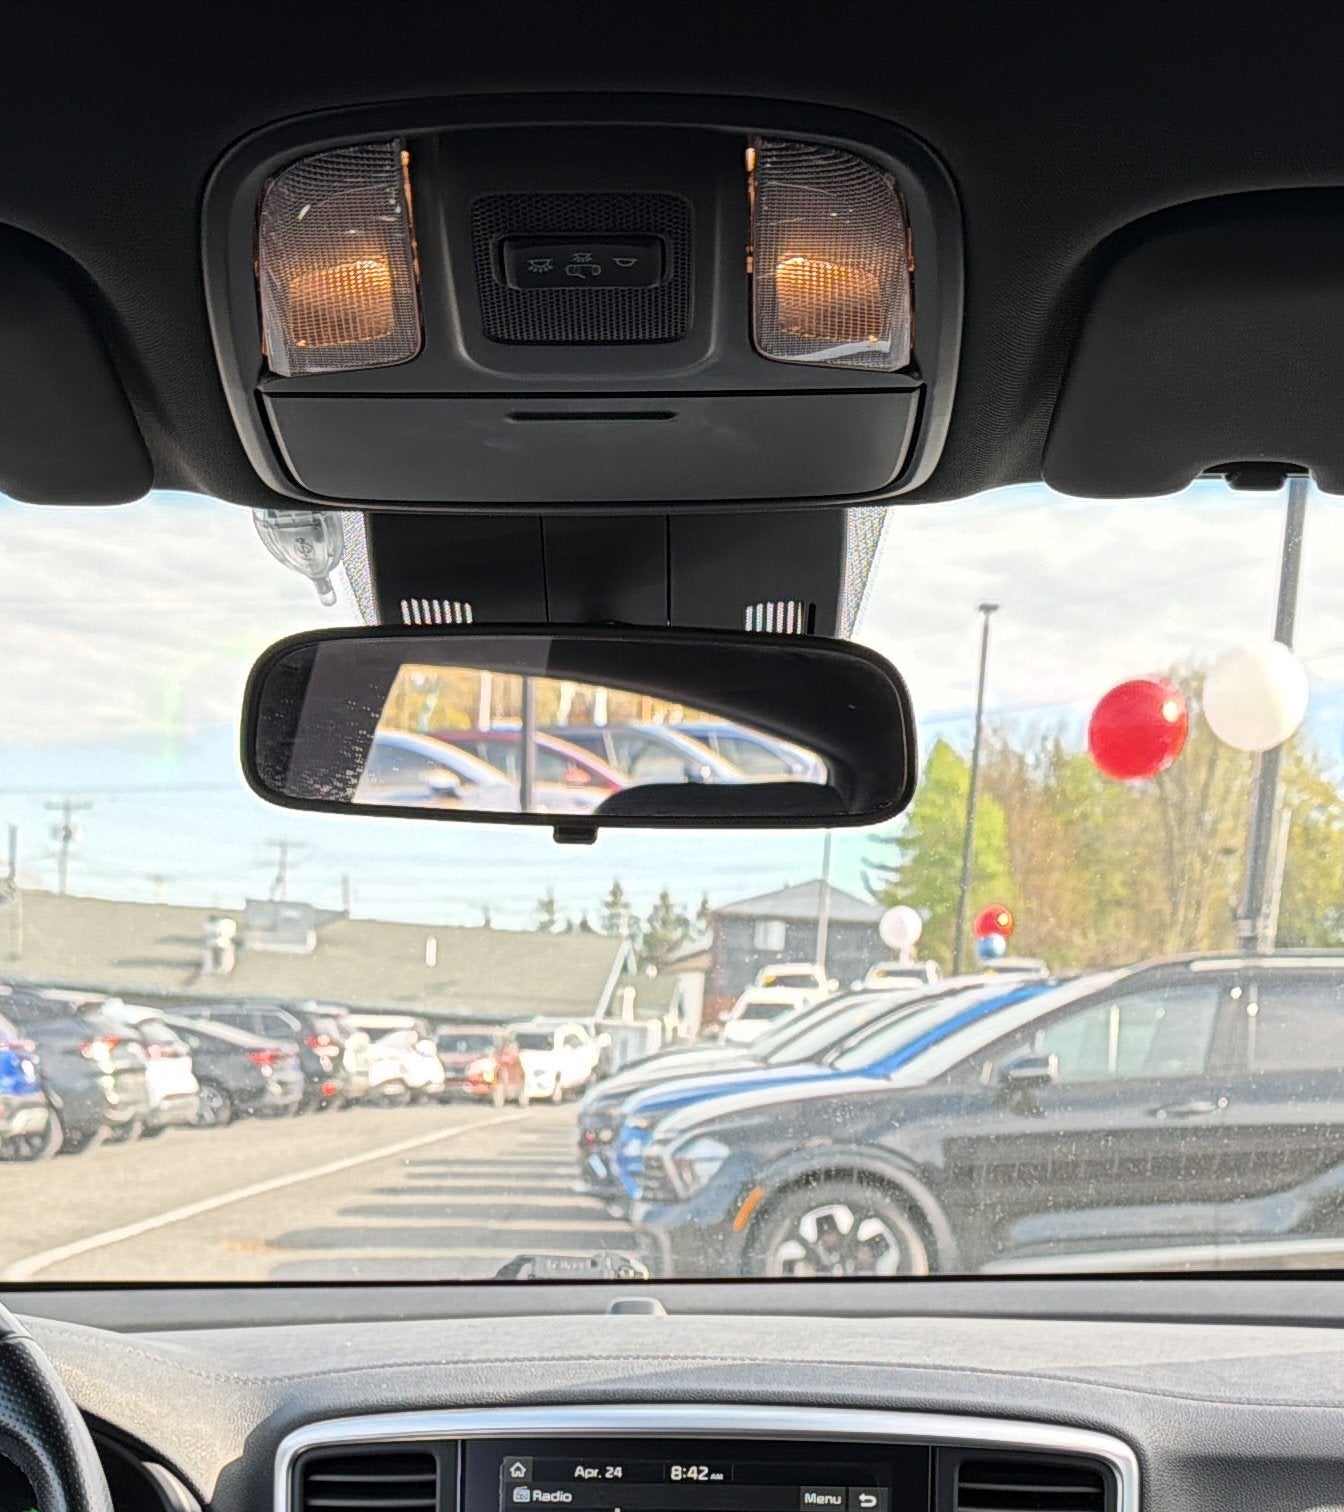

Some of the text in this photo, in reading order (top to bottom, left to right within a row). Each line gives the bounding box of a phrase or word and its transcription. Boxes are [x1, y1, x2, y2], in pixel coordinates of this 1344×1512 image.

[574, 1465, 623, 1481] Apr. 24
[670, 1465, 709, 1480] 8:42
[532, 1490, 573, 1503] Radio
[804, 1492, 842, 1505] Menu
